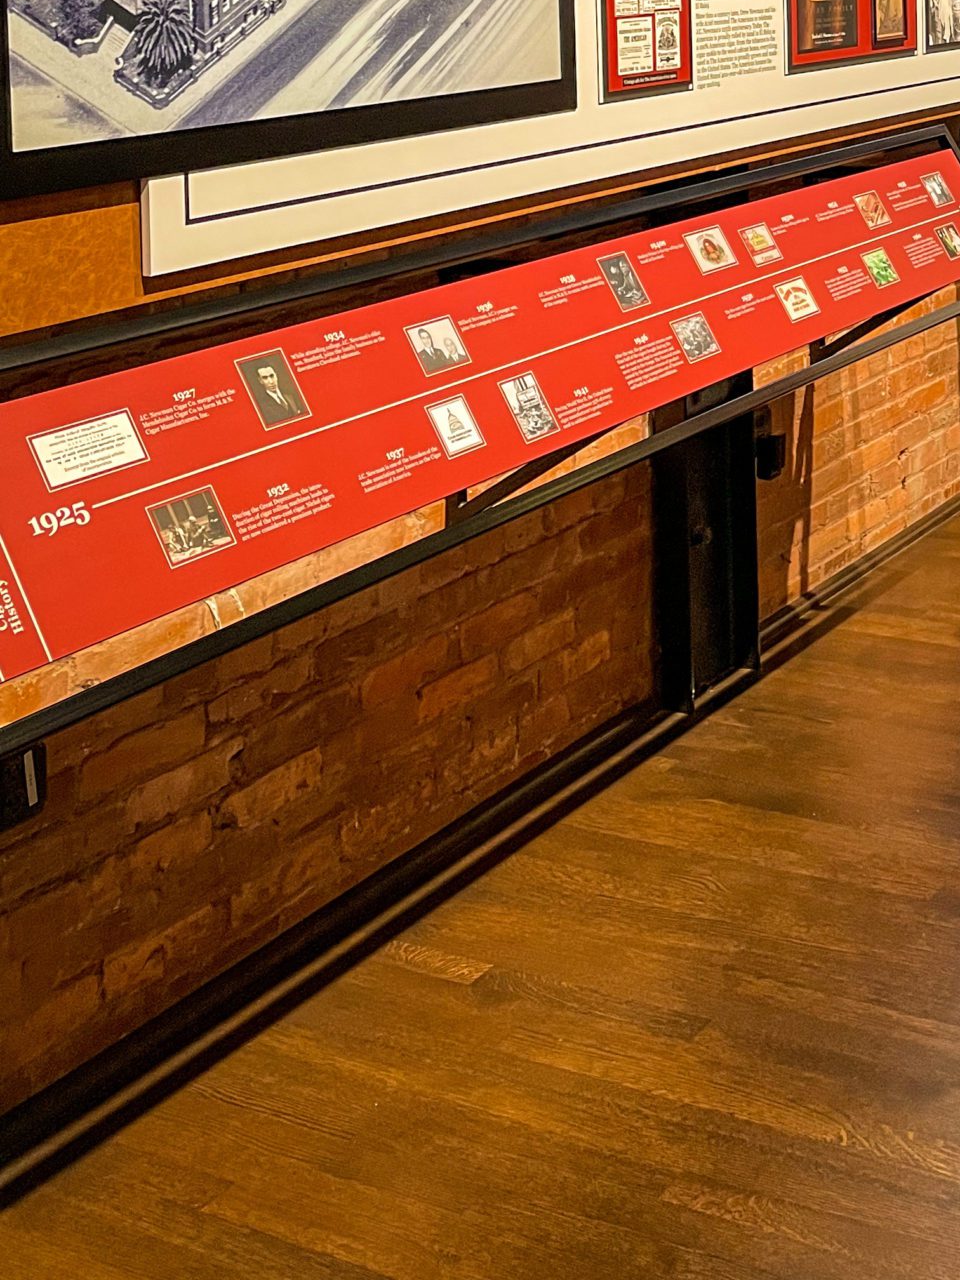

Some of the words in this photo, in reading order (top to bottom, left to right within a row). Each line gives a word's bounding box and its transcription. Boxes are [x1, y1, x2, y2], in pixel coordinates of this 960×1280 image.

[324, 330, 345, 342] 1934
[172, 388, 195, 402] 1927
[386, 447, 404, 460] 1937
[267, 483, 290, 497] 1932
[28, 501, 91, 536] 1925
